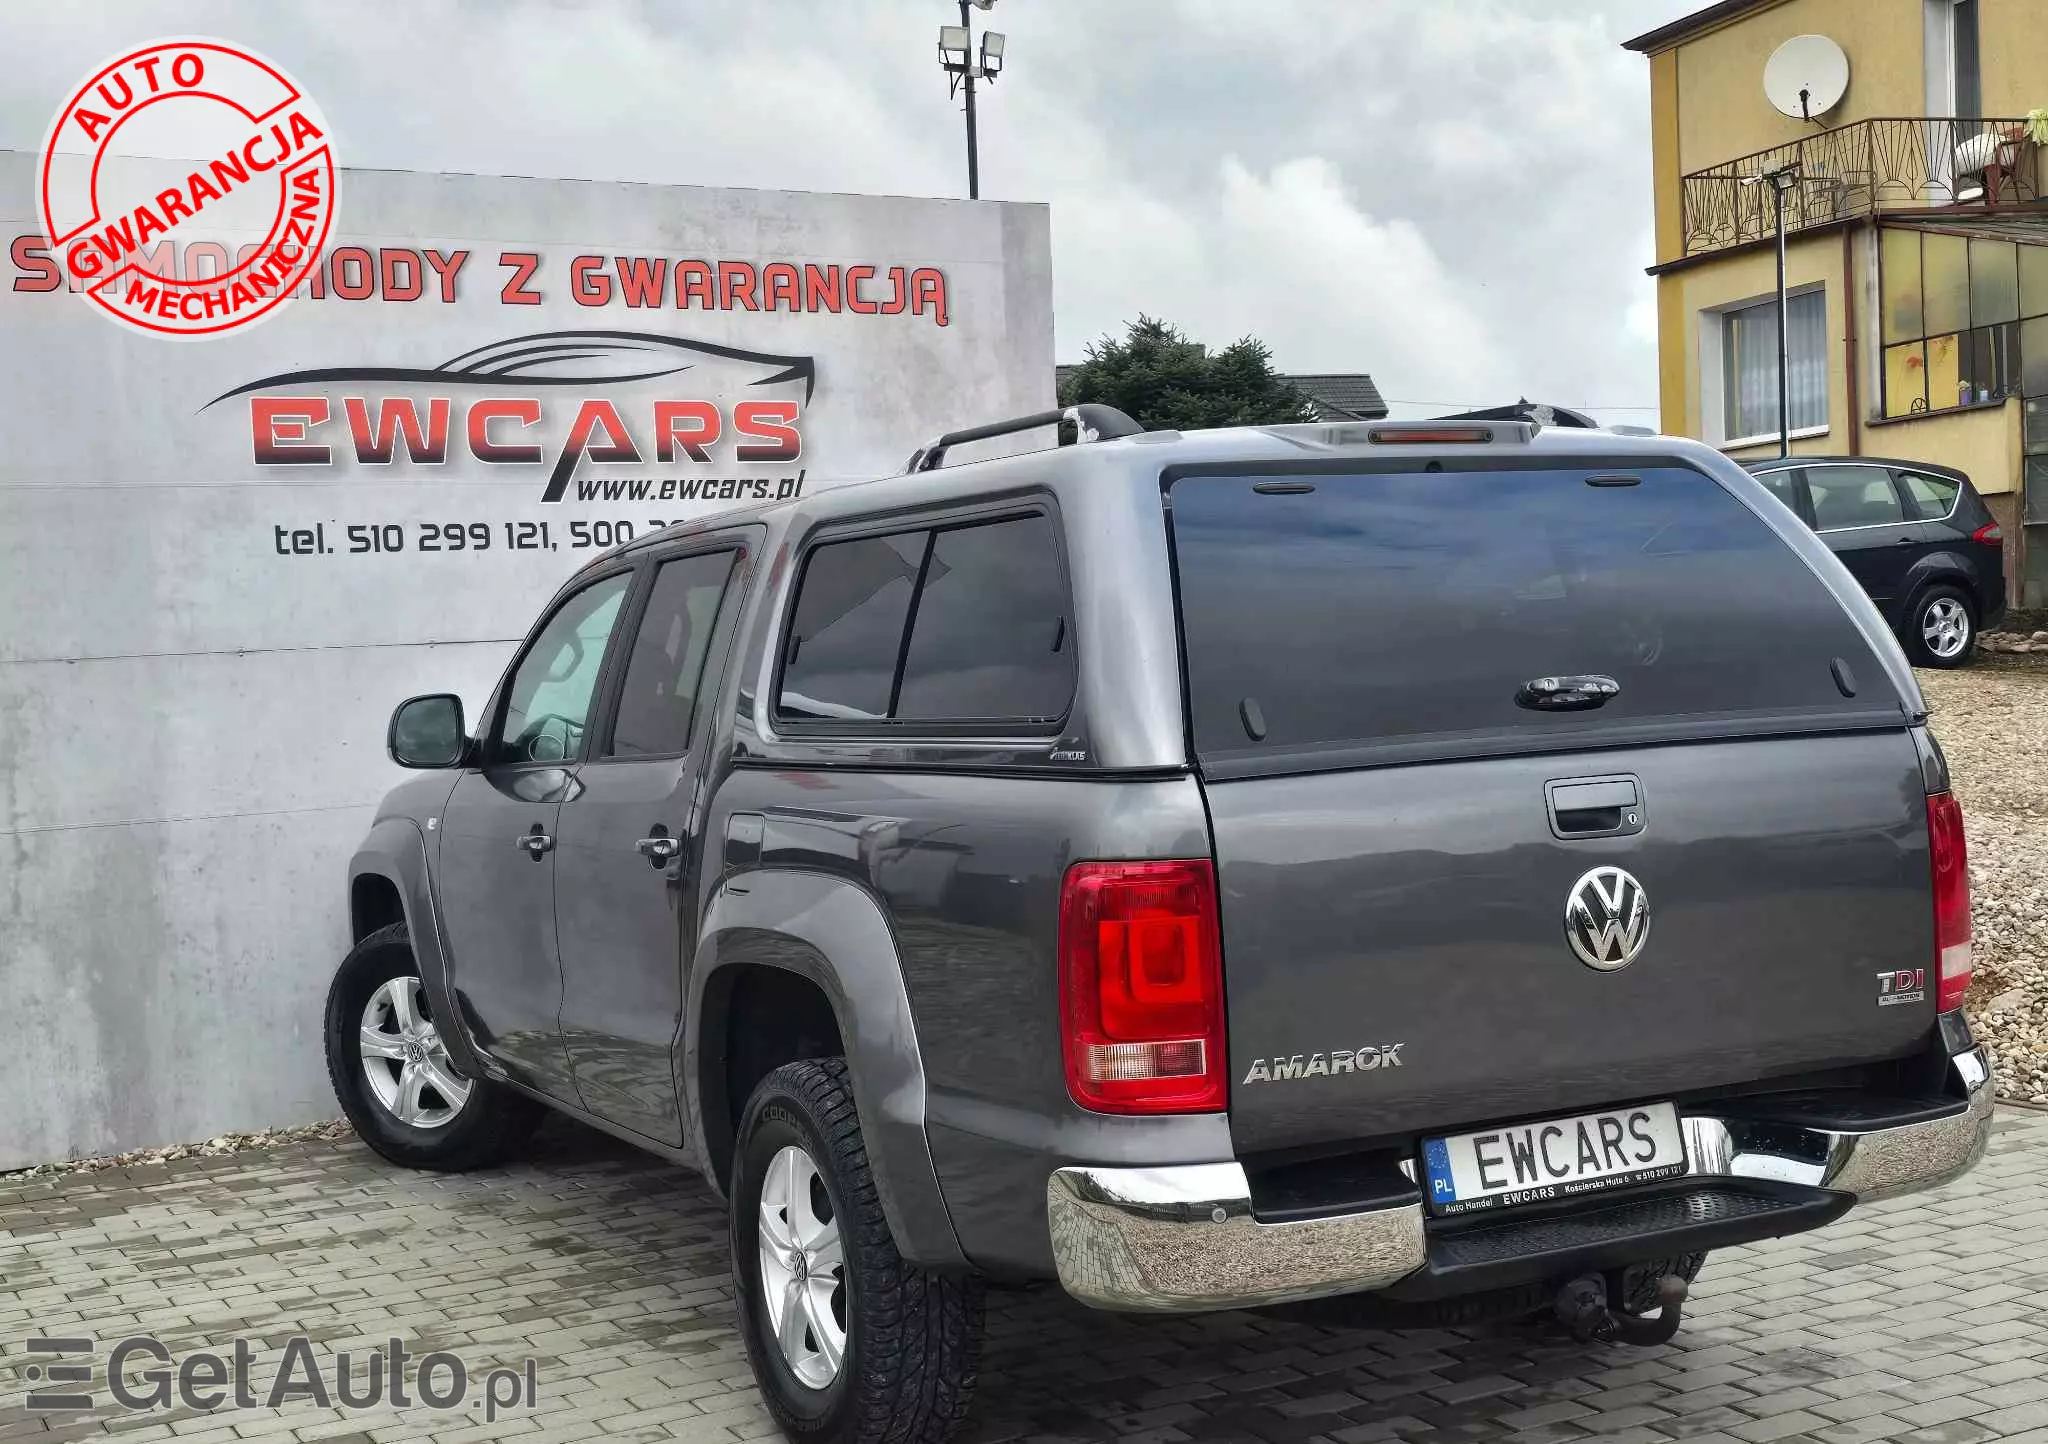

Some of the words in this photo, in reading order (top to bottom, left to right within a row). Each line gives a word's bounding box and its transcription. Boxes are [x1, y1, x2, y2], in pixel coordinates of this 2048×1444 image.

[10, 235, 469, 304] SAMOCHODY
[500, 253, 541, 305] Z
[571, 255, 948, 327] GWARANCJĄ
[249, 396, 801, 502] EWCARS
[578, 470, 806, 501] www.ewcars.pl
[275, 522, 333, 554] tel.
[347, 524, 404, 552] 510
[418, 523, 491, 551] 299
[505, 521, 557, 552] 121,
[569, 520, 635, 549] 500
[1877, 968, 1924, 993] TDI
[1243, 1043, 1405, 1085] AMAROK
[1473, 1112, 1657, 1190] EWCARS
[1434, 1179, 1452, 1194] PL
[1446, 1203, 1464, 1213] Auto
[1466, 1198, 1493, 1210] Handel
[1503, 1187, 1555, 1205] EWCARS
